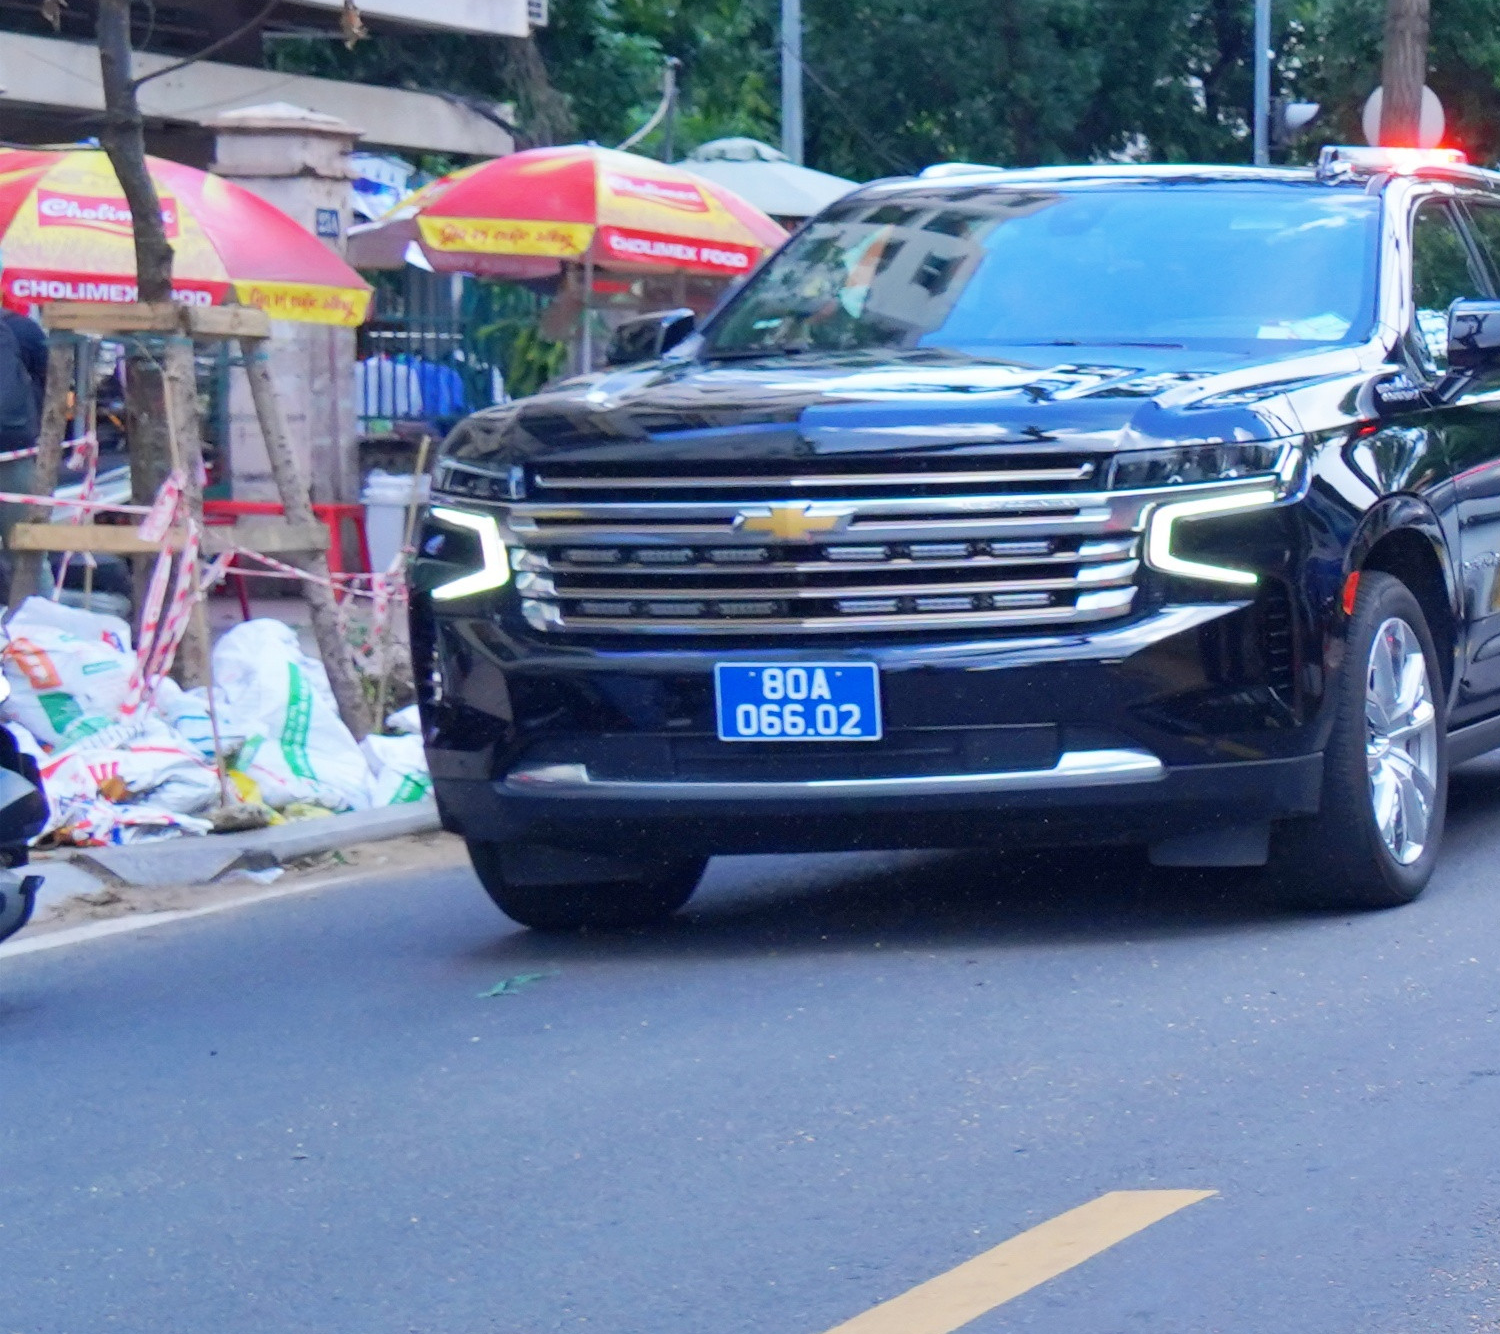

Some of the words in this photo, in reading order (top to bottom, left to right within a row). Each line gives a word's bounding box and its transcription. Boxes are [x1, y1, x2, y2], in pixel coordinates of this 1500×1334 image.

[609, 235, 698, 261] CHOLIMEX
[700, 247, 749, 268] FOOD
[762, 668, 832, 700] 80A
[736, 704, 862, 736] 066.02
